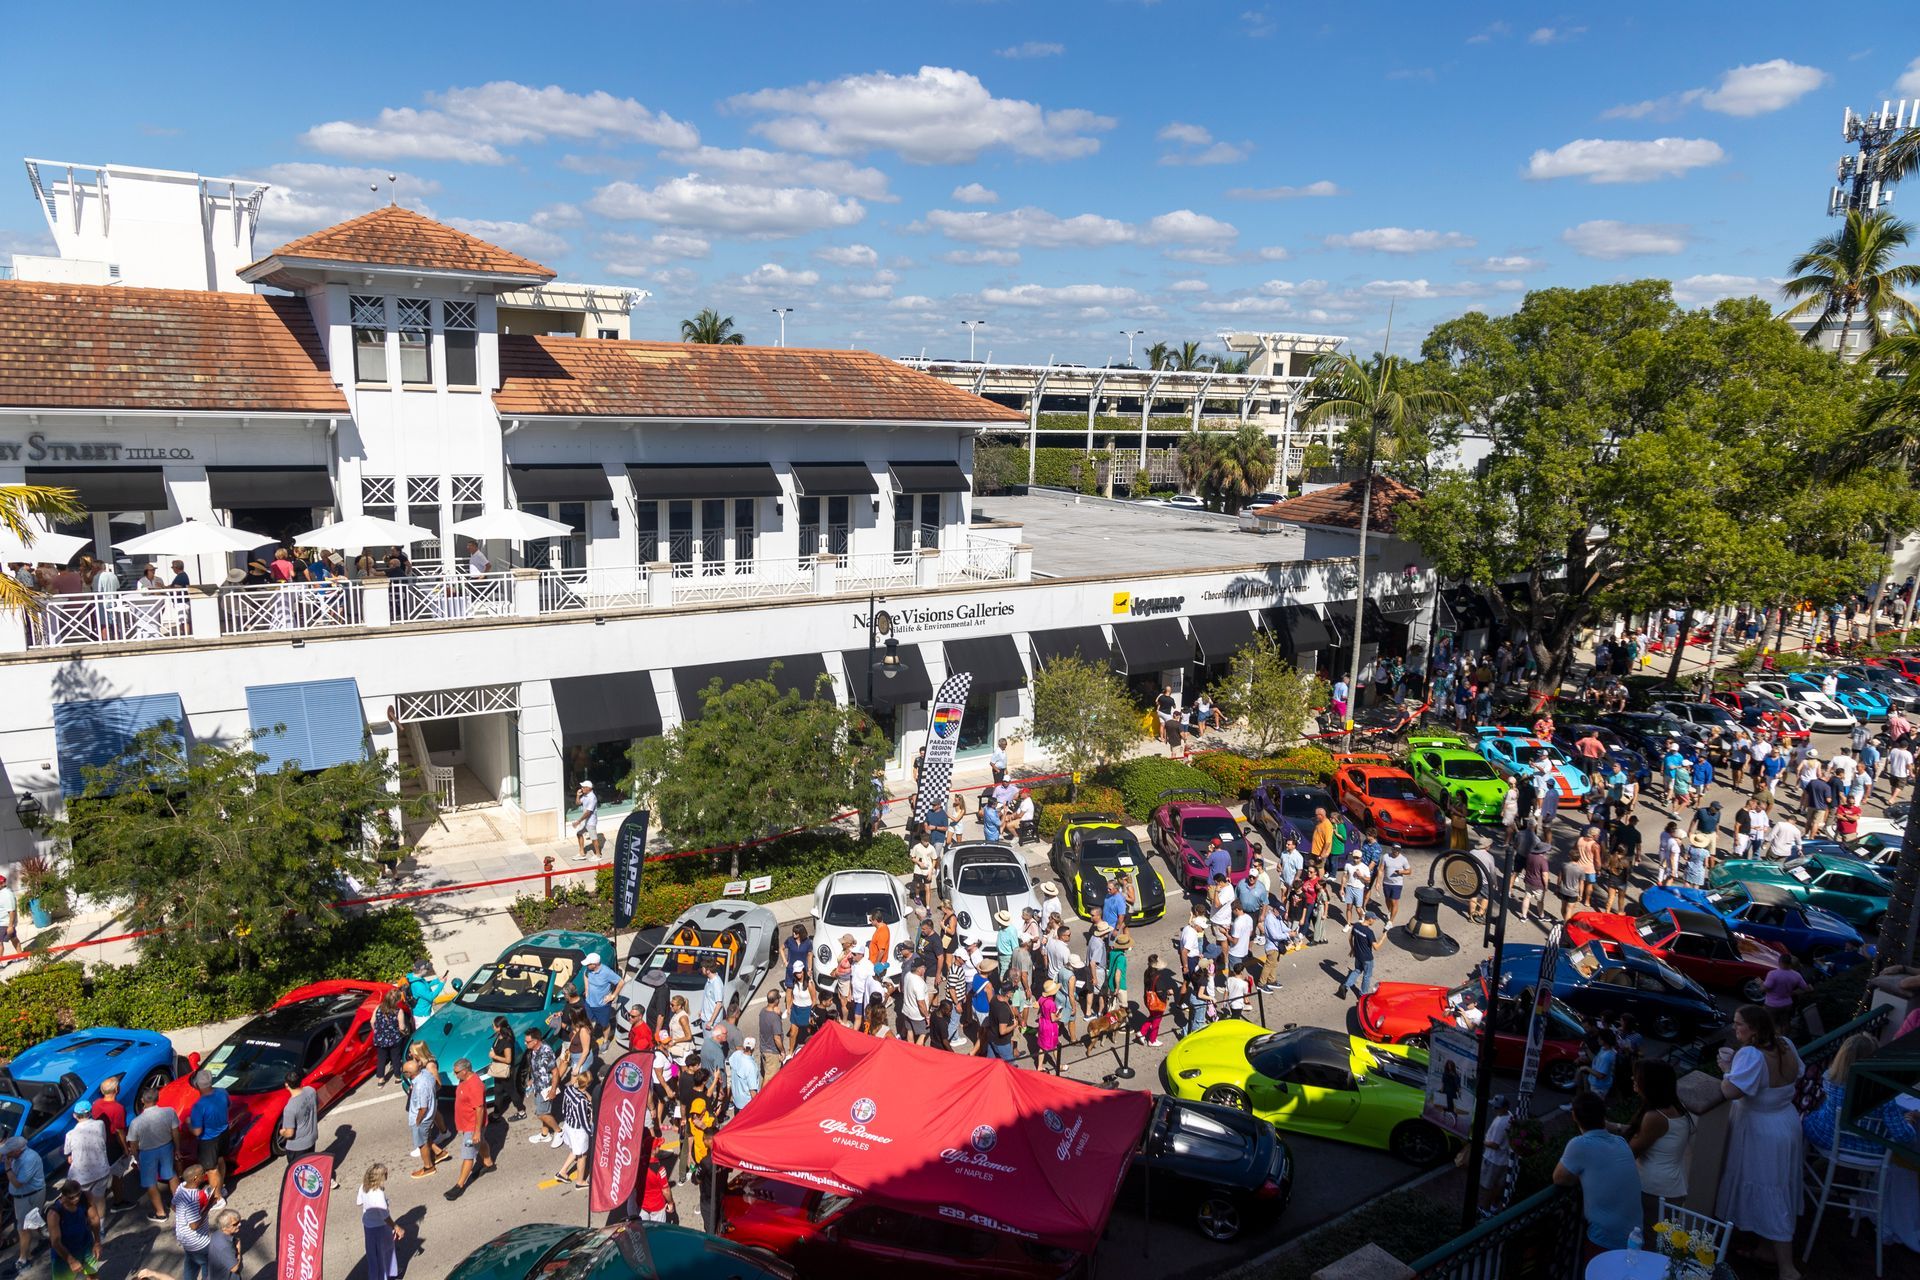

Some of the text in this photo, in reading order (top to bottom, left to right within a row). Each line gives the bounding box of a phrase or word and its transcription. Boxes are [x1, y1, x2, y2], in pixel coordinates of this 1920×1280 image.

[28, 434, 122, 461] STREET
[126, 448, 167, 460] TITLE
[169, 448, 194, 460] CO.
[852, 601, 1015, 629] Nae Visions Galleries
[891, 618, 986, 634] ildlife & Environmental Art
[623, 835, 642, 917] NAPLES
[819, 1118, 893, 1144] Alfa Romeo
[841, 1138, 870, 1151] NAPLES
[599, 1126, 612, 1168] of NAPLES
[610, 1098, 636, 1204] Alfa Romeo
[940, 1148, 1017, 1174] Alfa Romeo
[964, 1168, 993, 1182] NAPLES
[297, 1204, 319, 1254] Alfa
[286, 1233, 295, 1279] of NAPLES
